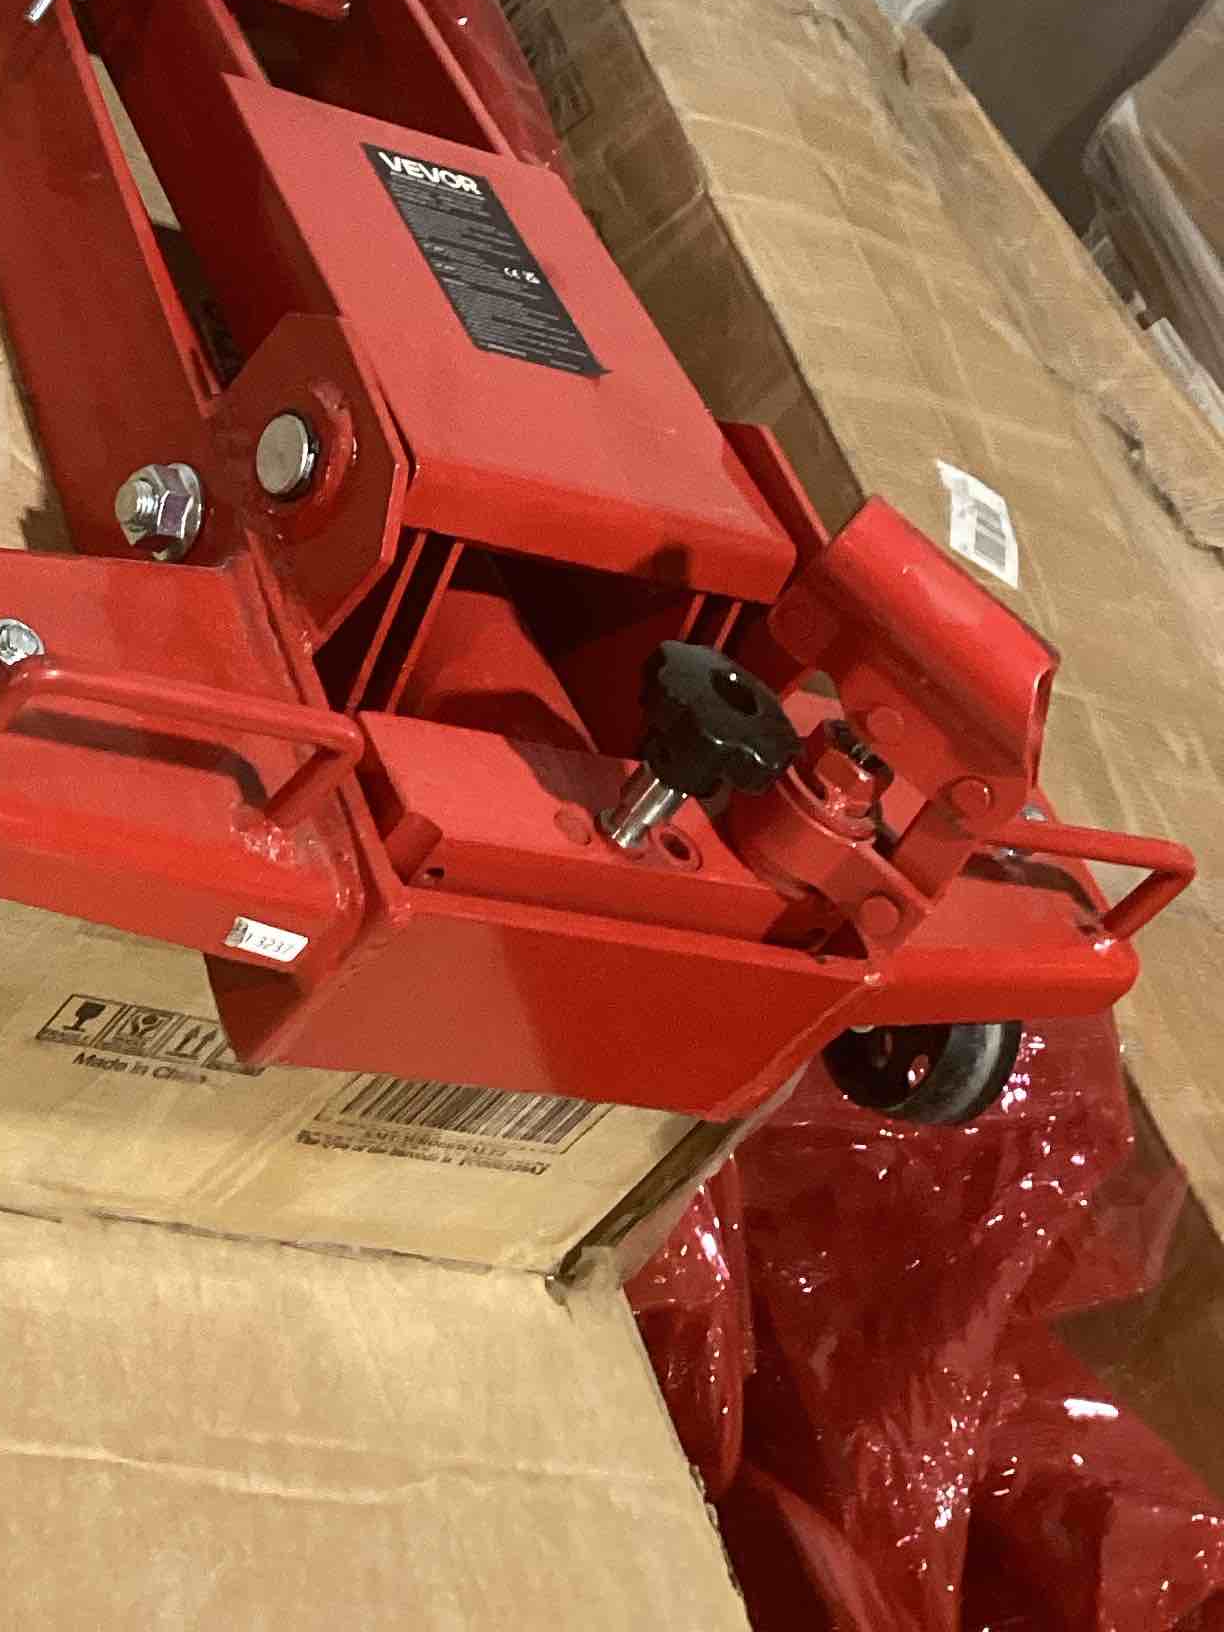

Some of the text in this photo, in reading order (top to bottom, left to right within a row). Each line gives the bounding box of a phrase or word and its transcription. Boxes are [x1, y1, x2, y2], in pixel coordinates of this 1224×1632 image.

[378, 151, 481, 196] VEVOR
[72, 1050, 128, 1073] Made
[130, 1060, 150, 1077] in
